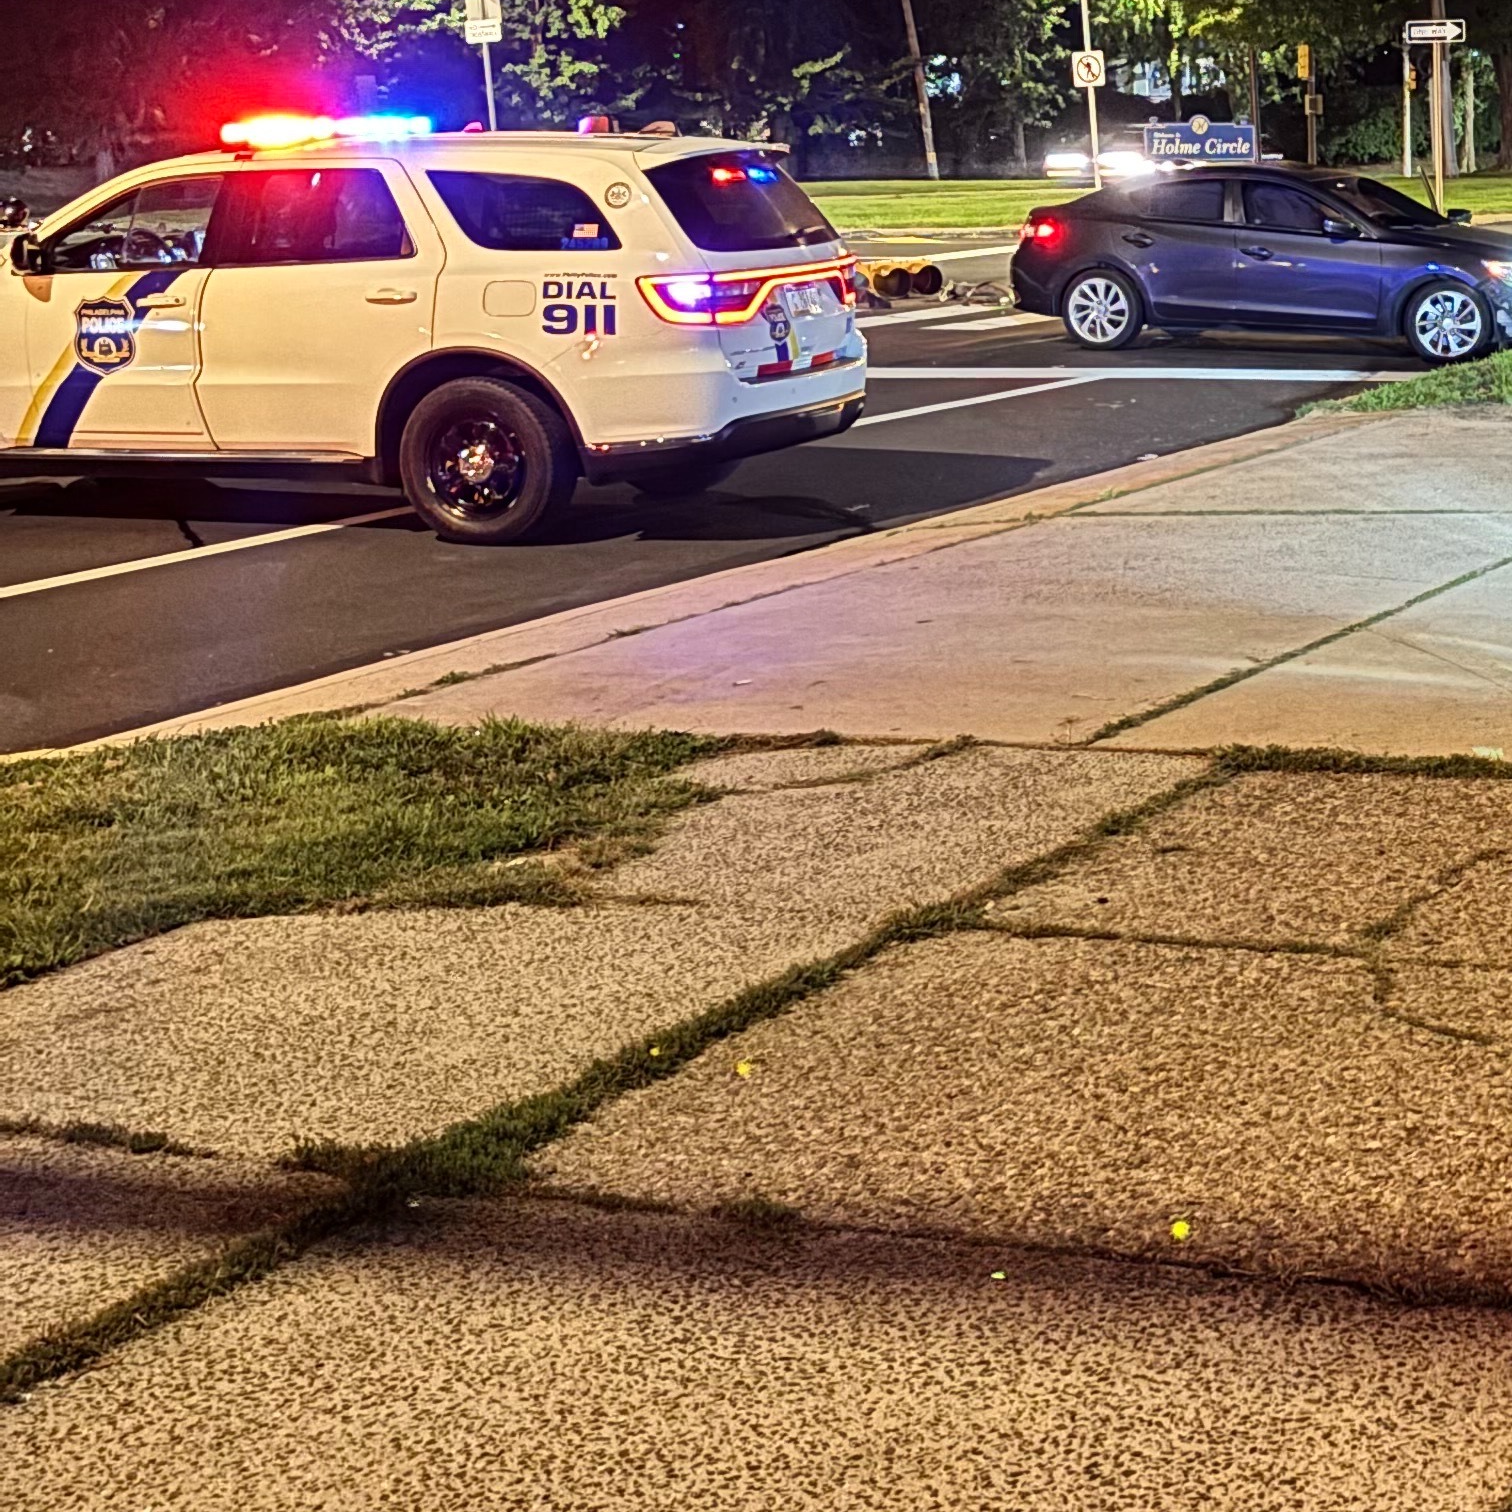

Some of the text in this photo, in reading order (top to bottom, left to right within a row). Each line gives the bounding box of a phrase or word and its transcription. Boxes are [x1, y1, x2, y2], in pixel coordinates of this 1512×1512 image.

[1151, 137, 1251, 155] Holme Circle
[542, 281, 616, 300] DIAL
[81, 316, 126, 334] POLICE
[542, 304, 616, 336] 911
